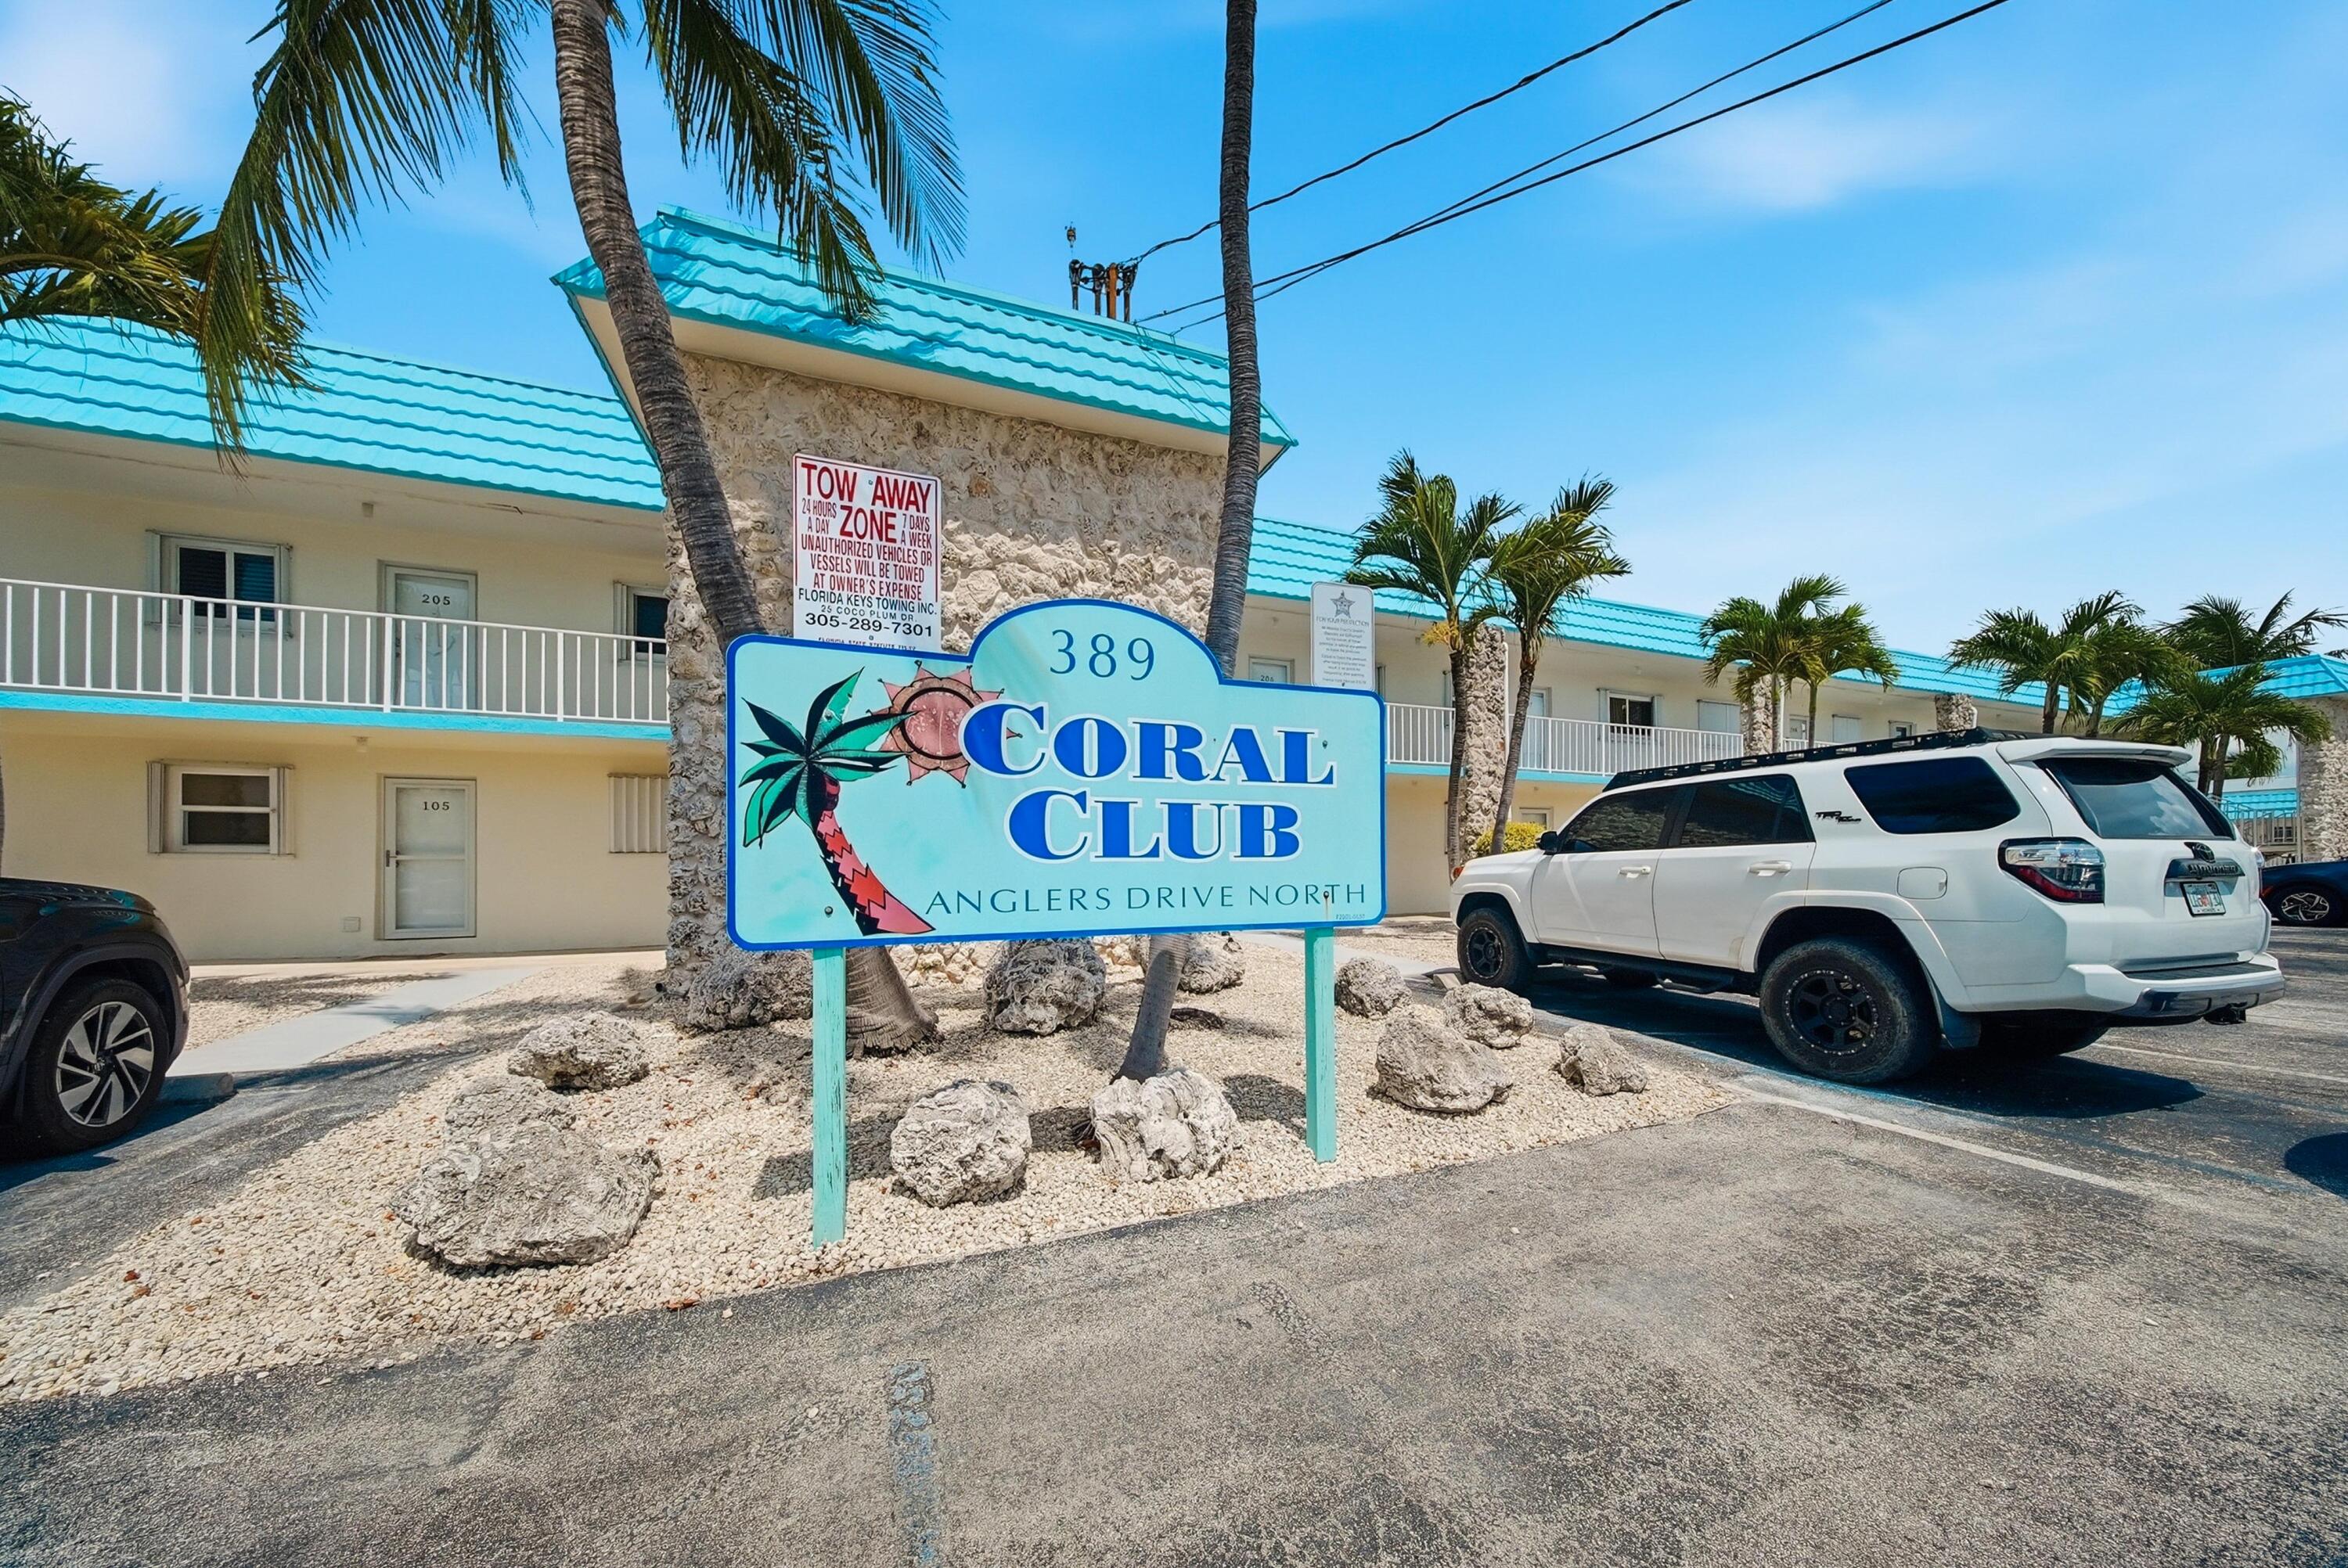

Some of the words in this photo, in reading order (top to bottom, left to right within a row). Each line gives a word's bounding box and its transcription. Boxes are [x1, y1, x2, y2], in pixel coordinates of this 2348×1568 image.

[801, 462, 858, 502] TOW
[871, 475, 931, 513] AWAY
[802, 498, 811, 515] 24
[812, 499, 837, 519] HOURS
[807, 516, 812, 532] A
[816, 517, 830, 534] DAY
[840, 505, 897, 543] ZONE
[902, 513, 907, 529] 7
[909, 514, 930, 532] DAYS
[801, 534, 873, 559] UNAUTHORIZED
[876, 544, 918, 565] VEHICLES
[920, 550, 932, 566] OR
[901, 530, 906, 546] A
[909, 532, 932, 548] WEEK
[810, 553, 852, 574] VESSELS
[855, 559, 876, 577] WILL
[879, 562, 890, 579] BE
[893, 564, 924, 583] TOWED
[422, 594, 451, 606] 205
[813, 573, 826, 589] AT
[830, 574, 876, 596] OWNER'S
[879, 581, 922, 601] EXPENSE
[798, 588, 844, 605] FLORIDA
[846, 593, 873, 608] KEYS
[876, 597, 915, 613] TOWING
[917, 603, 938, 615] INC.
[821, 604, 832, 613] 25
[836, 606, 866, 617] COCO
[870, 610, 897, 620] PLUM
[901, 613, 917, 622] DR.
[805, 613, 932, 637] 305-289-7301
[1050, 629, 1155, 681] 389
[960, 701, 1336, 786] CORAL
[423, 801, 450, 811] 105
[1007, 788, 1302, 861] CLUB
[925, 886, 1111, 915] ANGLERS
[1127, 886, 1233, 910] DRIVE
[1249, 883, 1365, 906] NORTH
